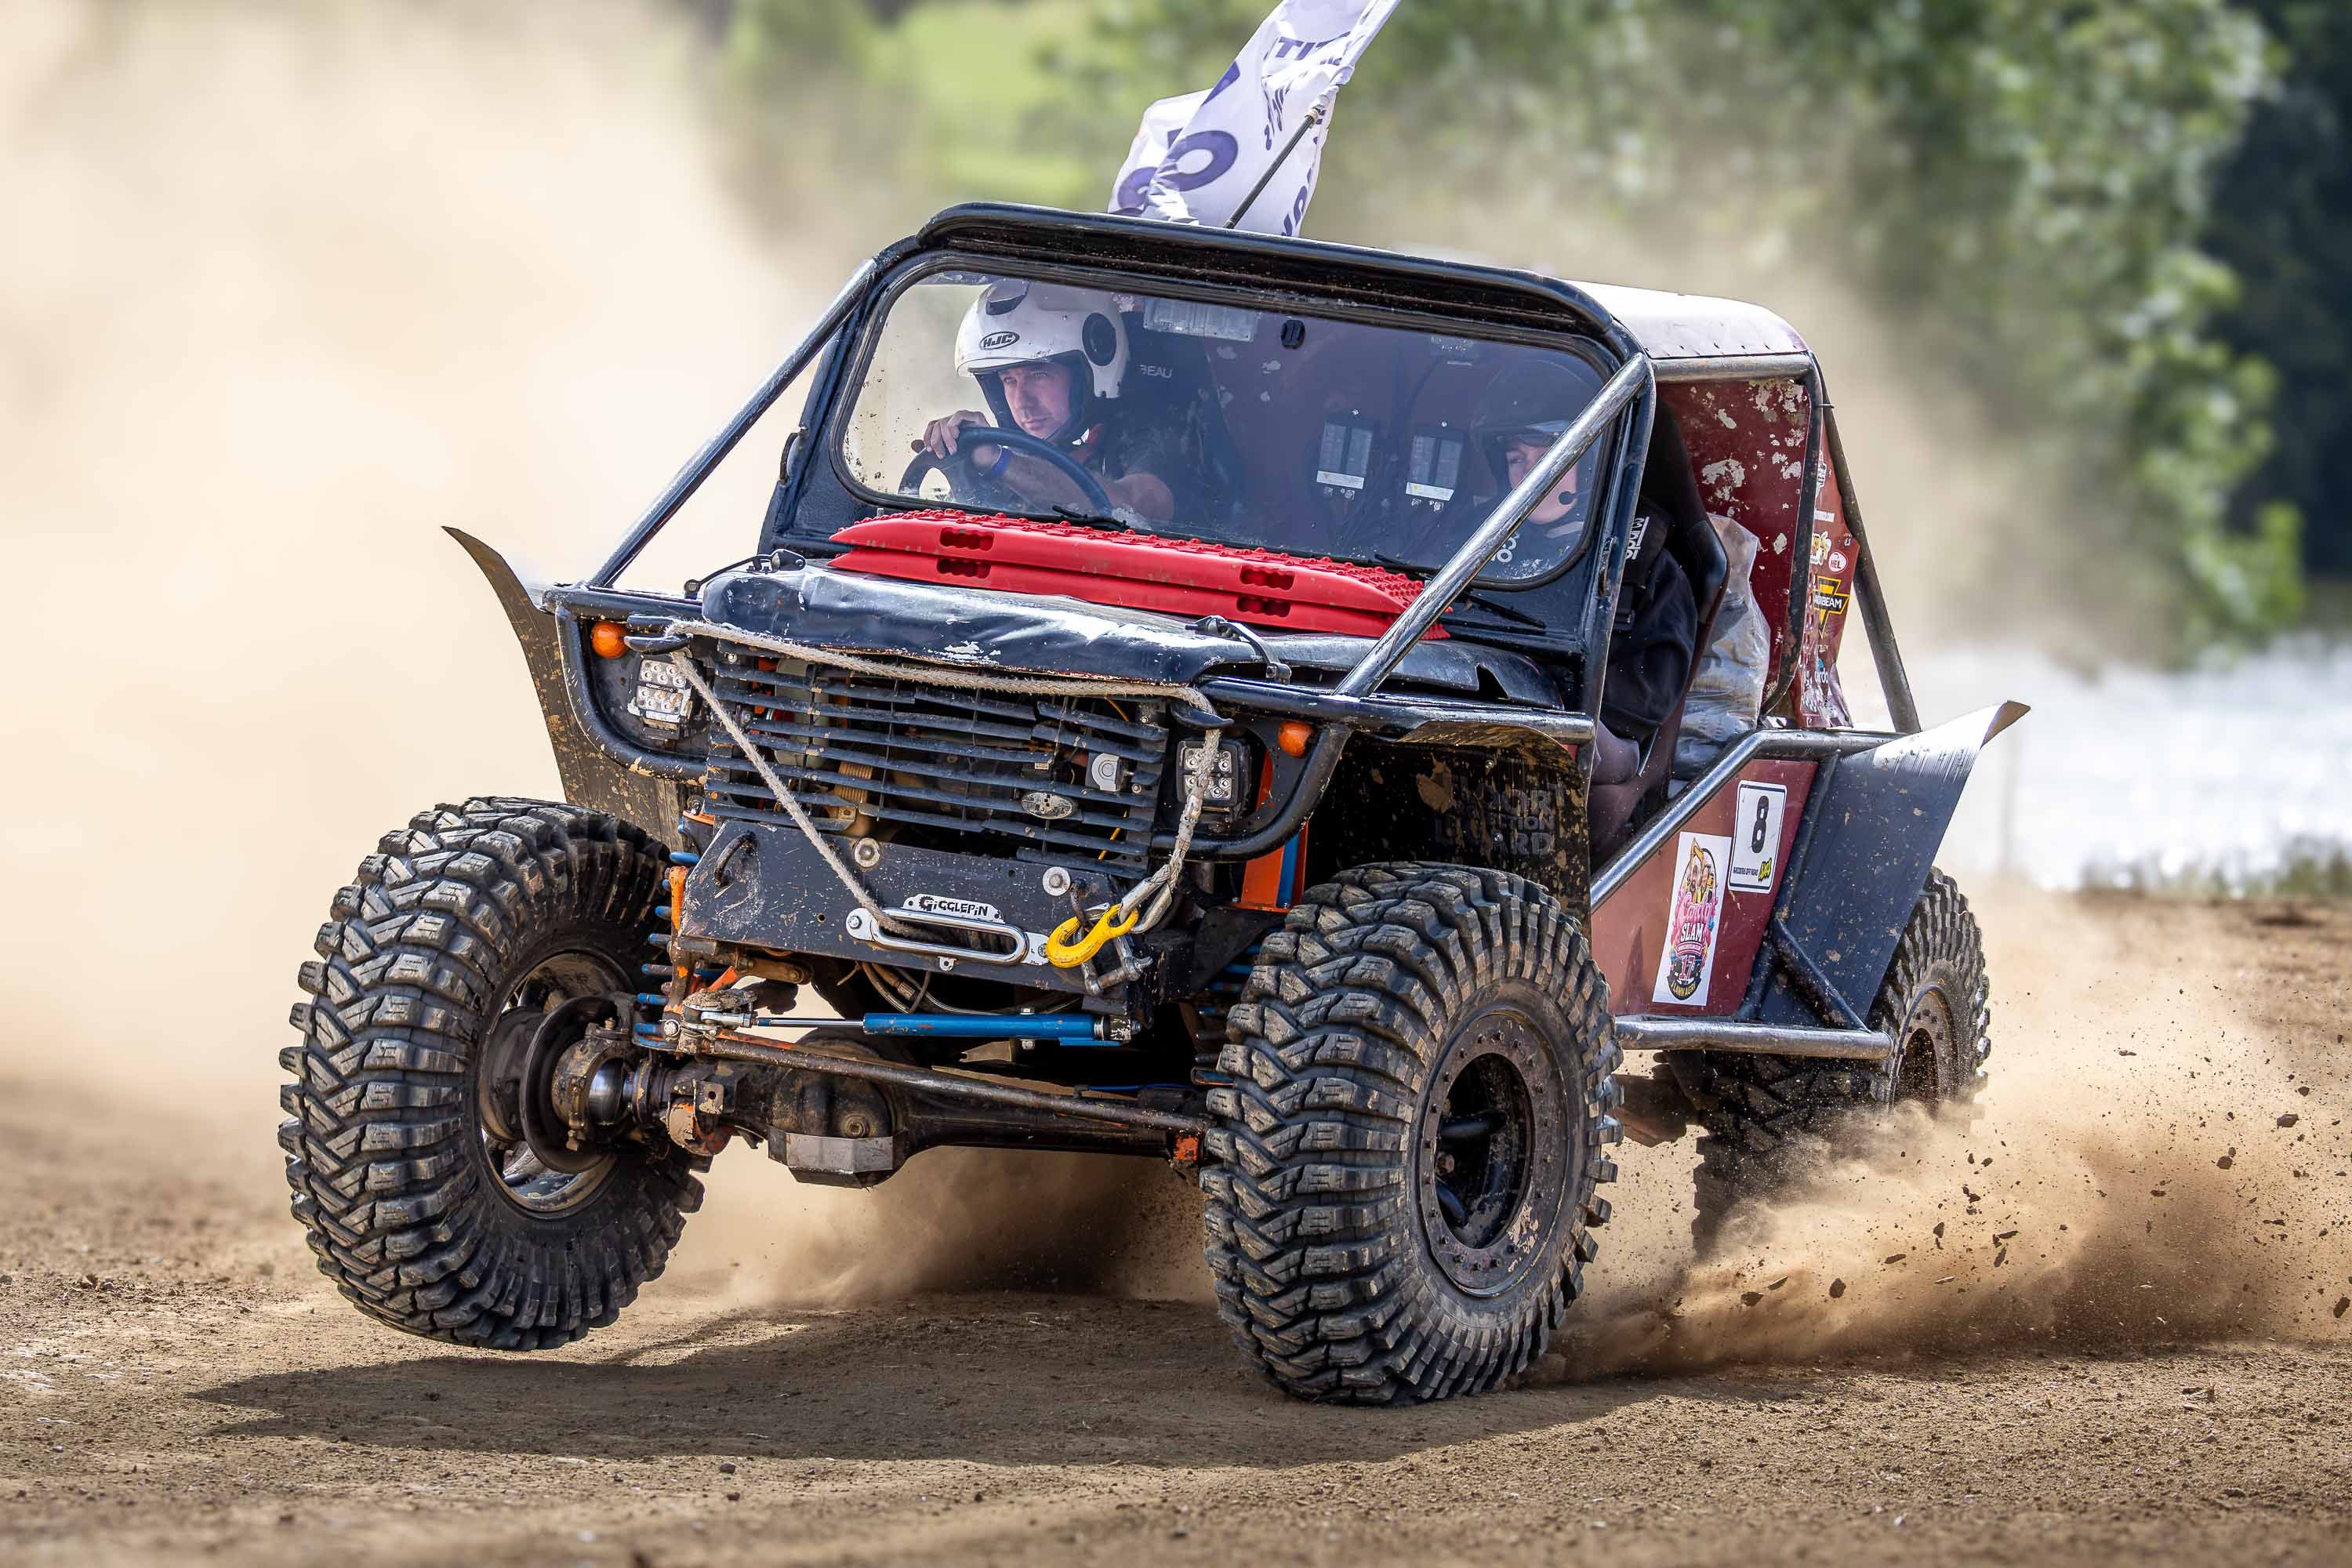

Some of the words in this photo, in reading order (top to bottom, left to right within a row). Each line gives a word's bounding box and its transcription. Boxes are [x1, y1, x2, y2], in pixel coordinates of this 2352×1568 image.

[983, 334, 1013, 347] HJC
[1830, 560, 1842, 569] HEL
[1751, 795, 1769, 854] 8
[1680, 922, 1704, 942] SLAM
[1679, 954, 1696, 981] 17
